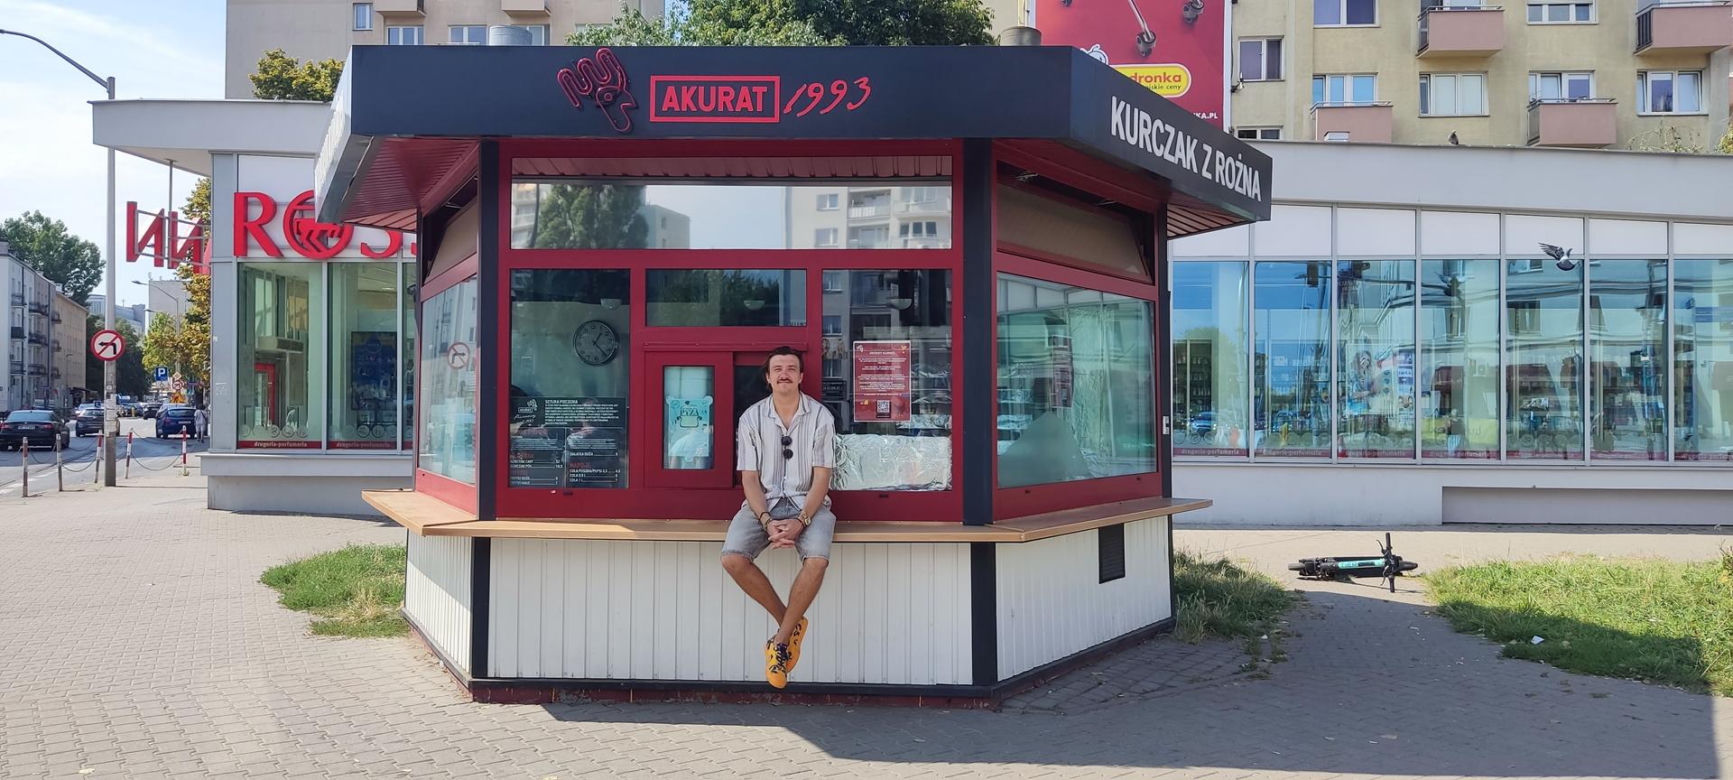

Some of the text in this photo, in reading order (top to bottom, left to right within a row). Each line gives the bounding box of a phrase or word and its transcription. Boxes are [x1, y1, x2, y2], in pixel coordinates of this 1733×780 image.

[1131, 72, 1182, 83] dronka
[661, 76, 872, 117] AKURAT 1993
[1193, 111, 1218, 119] KA.PL
[1111, 96, 1262, 202] KURCZAK Z ROŻNA
[158, 367, 166, 377] P
